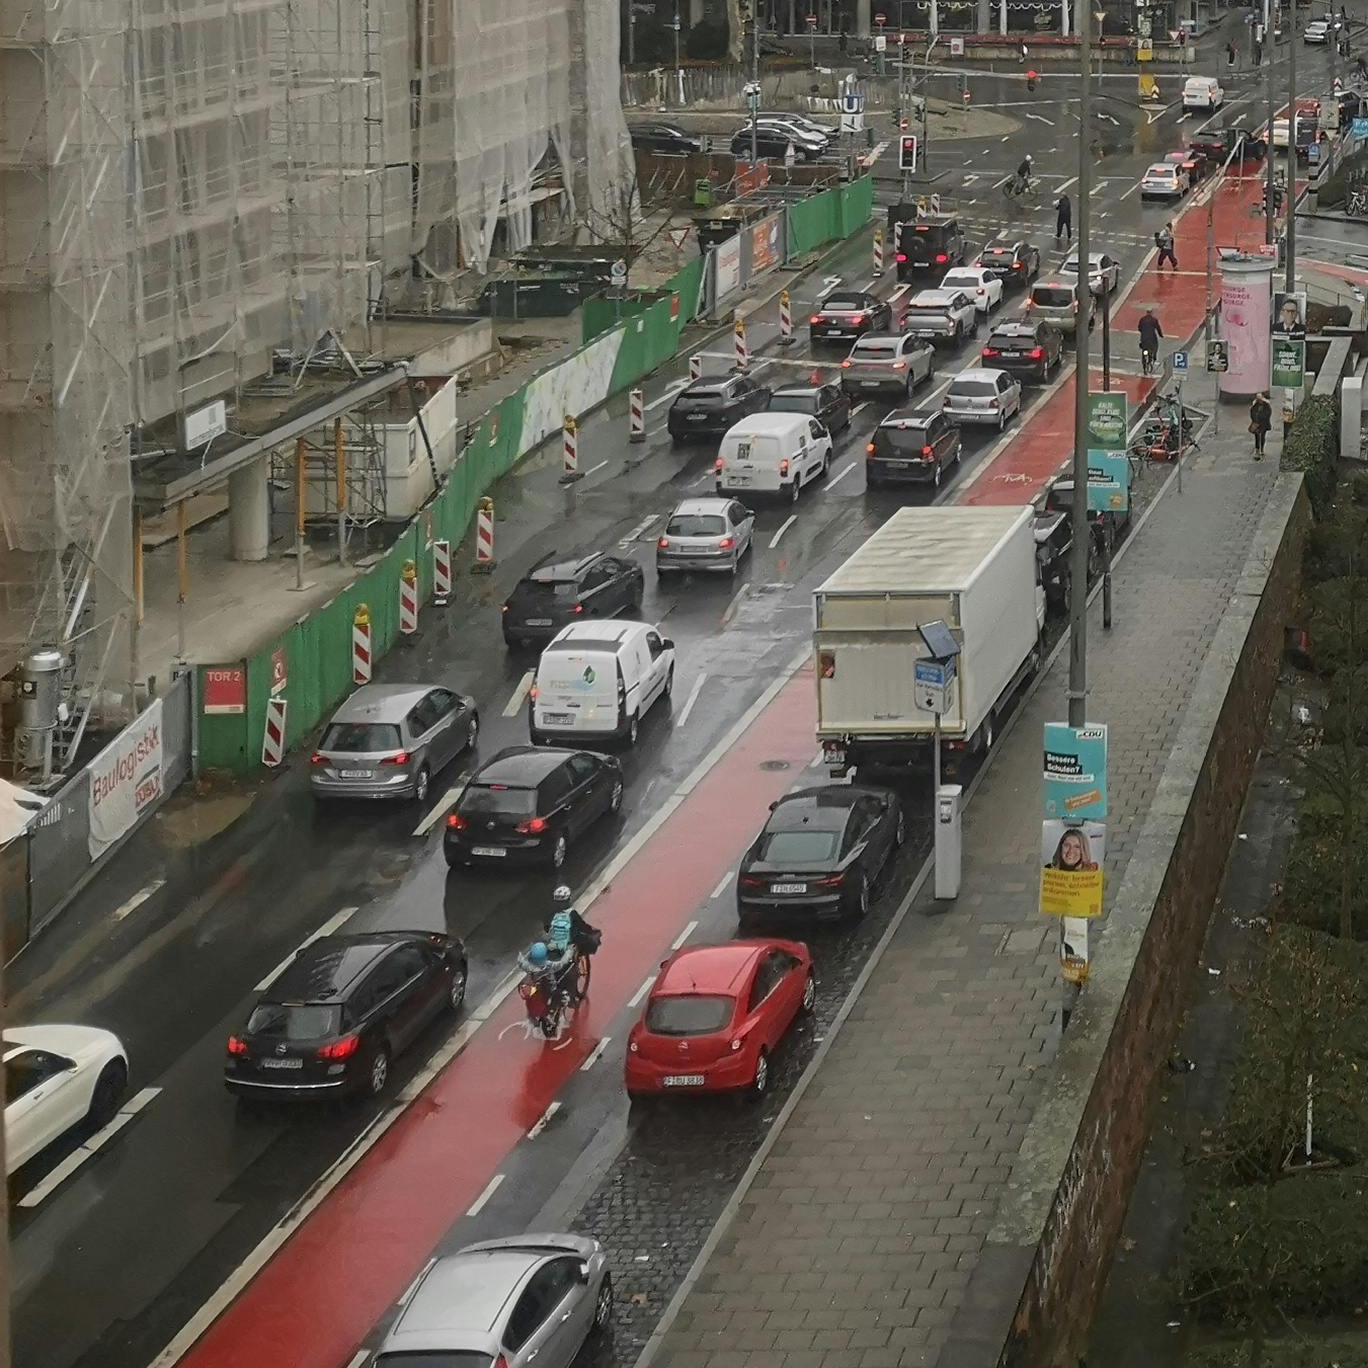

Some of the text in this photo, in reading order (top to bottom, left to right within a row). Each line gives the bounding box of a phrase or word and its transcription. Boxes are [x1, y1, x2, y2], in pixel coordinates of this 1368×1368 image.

[842, 96, 858, 113] U
[1174, 352, 1184, 367] P
[207, 671, 241, 682] TOR 2
[1046, 753, 1076, 764] Bessere
[93, 724, 160, 808] Baulogistik
[1047, 763, 1080, 773] Schulen?
